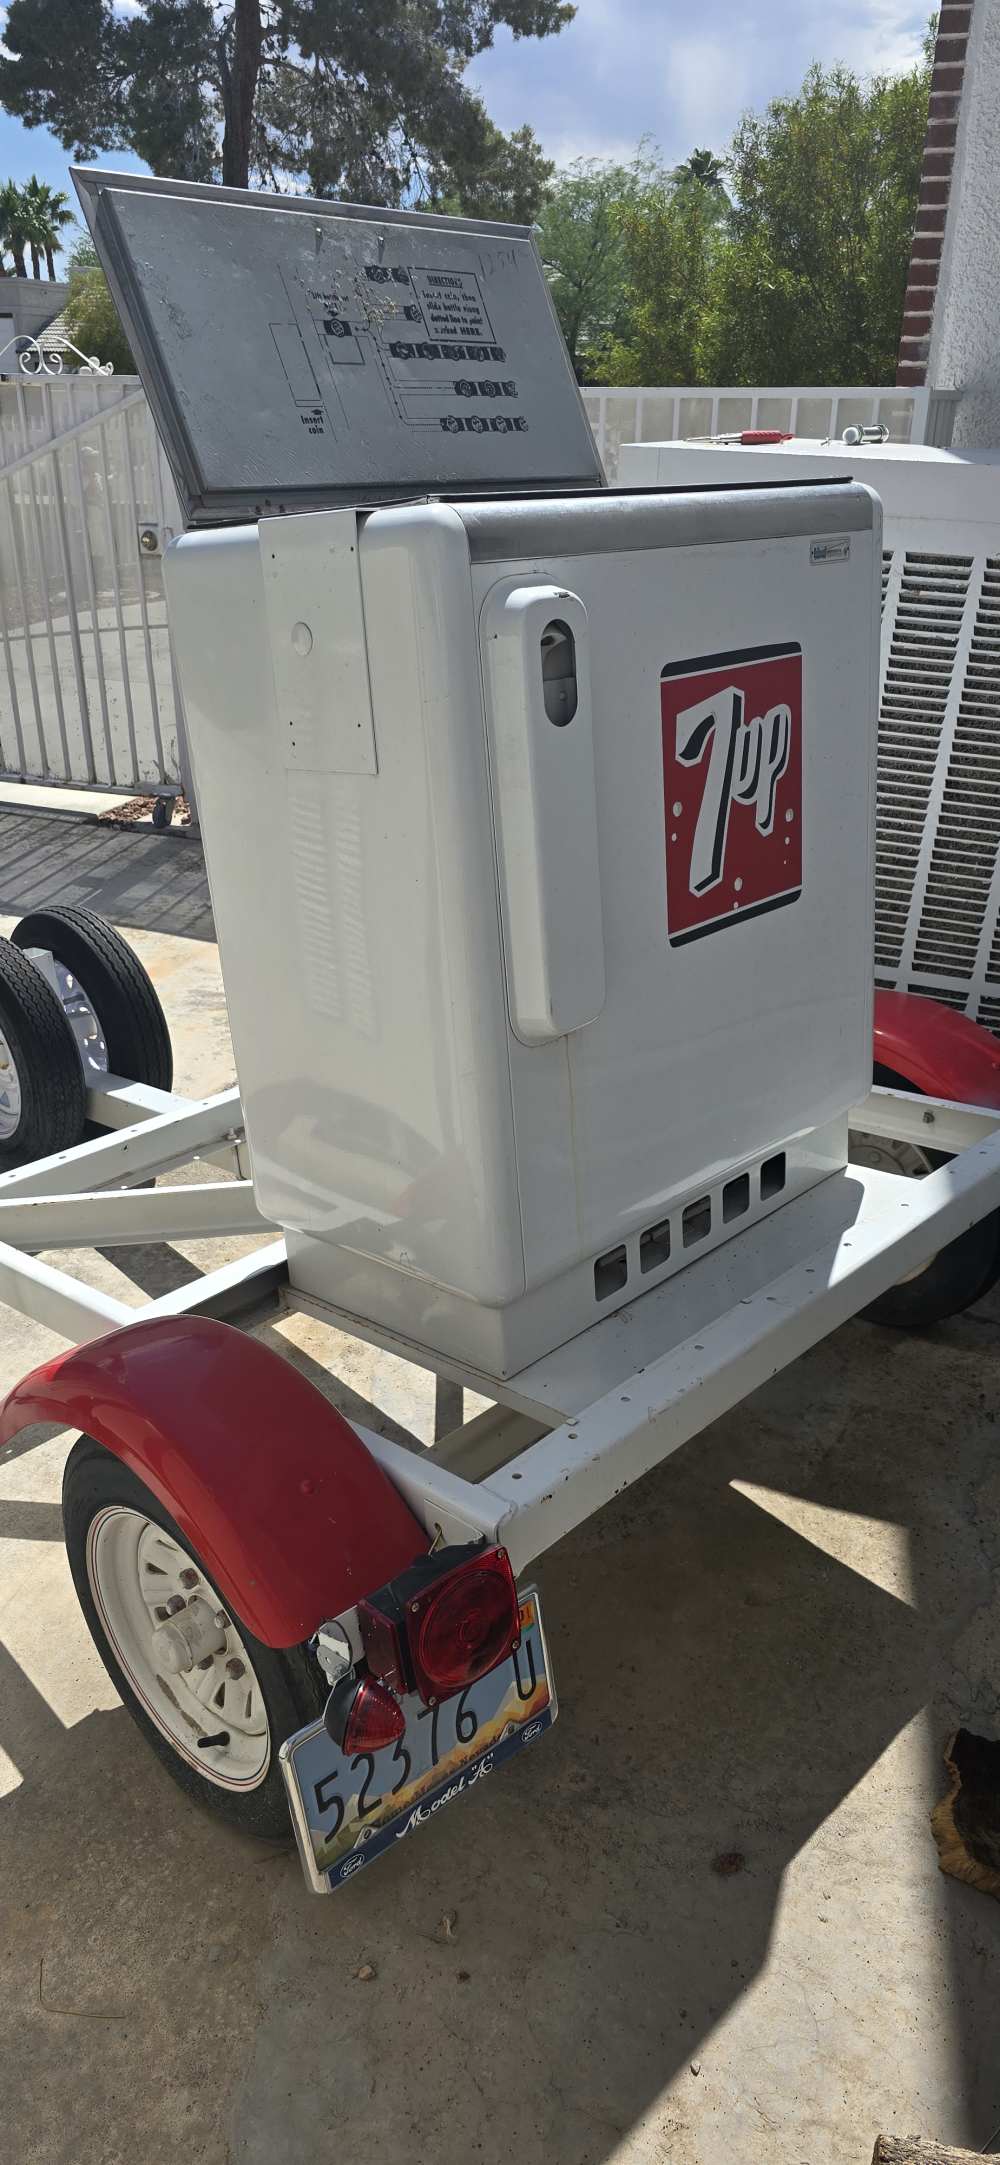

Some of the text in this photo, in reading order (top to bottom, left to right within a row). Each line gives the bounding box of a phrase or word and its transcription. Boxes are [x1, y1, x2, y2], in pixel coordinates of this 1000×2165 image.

[426, 275, 462, 287] DIRECTIONS
[461, 293, 476, 302] then
[426, 301, 441, 311] slide
[442, 302, 461, 312] bottle
[431, 313, 449, 322] dotted
[449, 314, 460, 323] line
[461, 316, 468, 324] to
[300, 415, 324, 425] Insert
[308, 425, 325, 434] coin
[523, 1723, 541, 1742] Ford
[314, 1685, 478, 1844] 52376
[512, 1640, 536, 1700] U
[396, 1776, 465, 1838] Model
[342, 1855, 363, 1876] Ford
